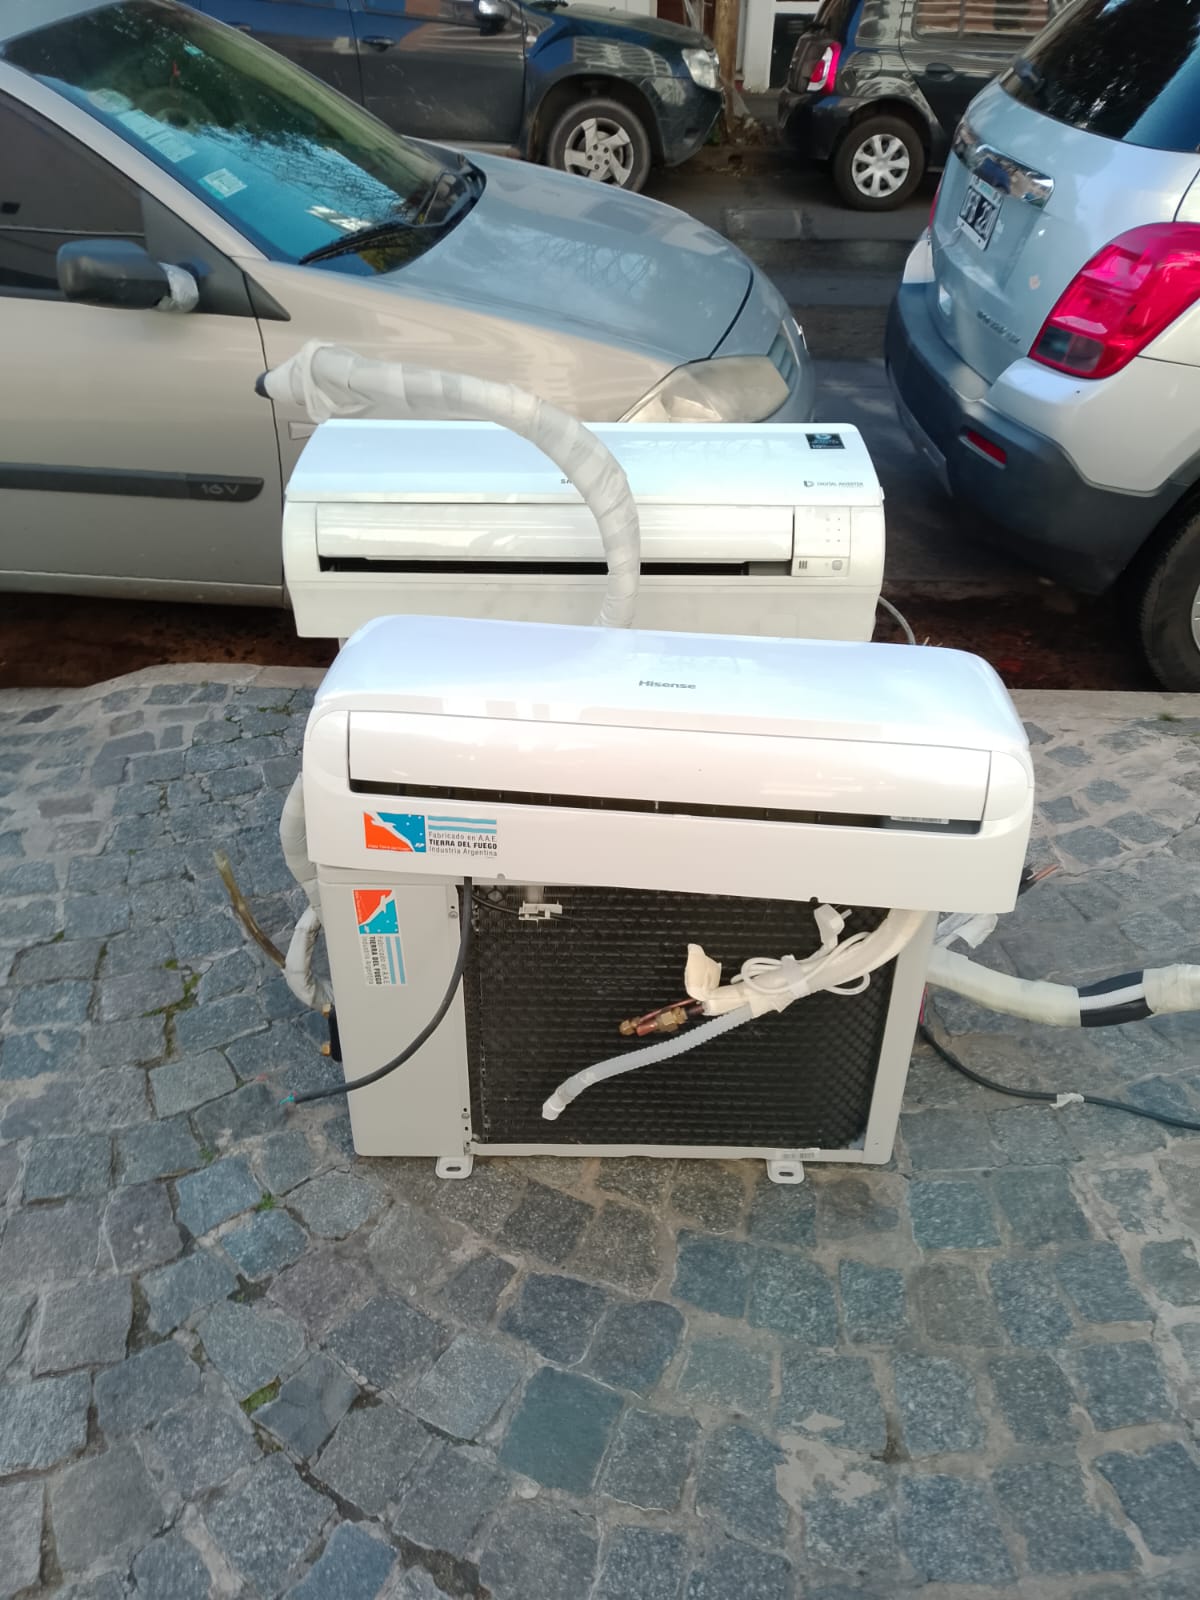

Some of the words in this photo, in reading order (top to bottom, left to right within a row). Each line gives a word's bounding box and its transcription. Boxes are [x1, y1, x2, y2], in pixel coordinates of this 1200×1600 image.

[201, 483, 240, 496] 16V
[638, 680, 697, 690] Hisense
[428, 831, 465, 840] Fabricado
[429, 838, 456, 847] TIERRA
[457, 840, 471, 849] DEL
[473, 842, 498, 850] FUEGO
[429, 846, 461, 854] Industria
[462, 847, 498, 857] Argentina
[369, 936, 378, 955] TIERRA
